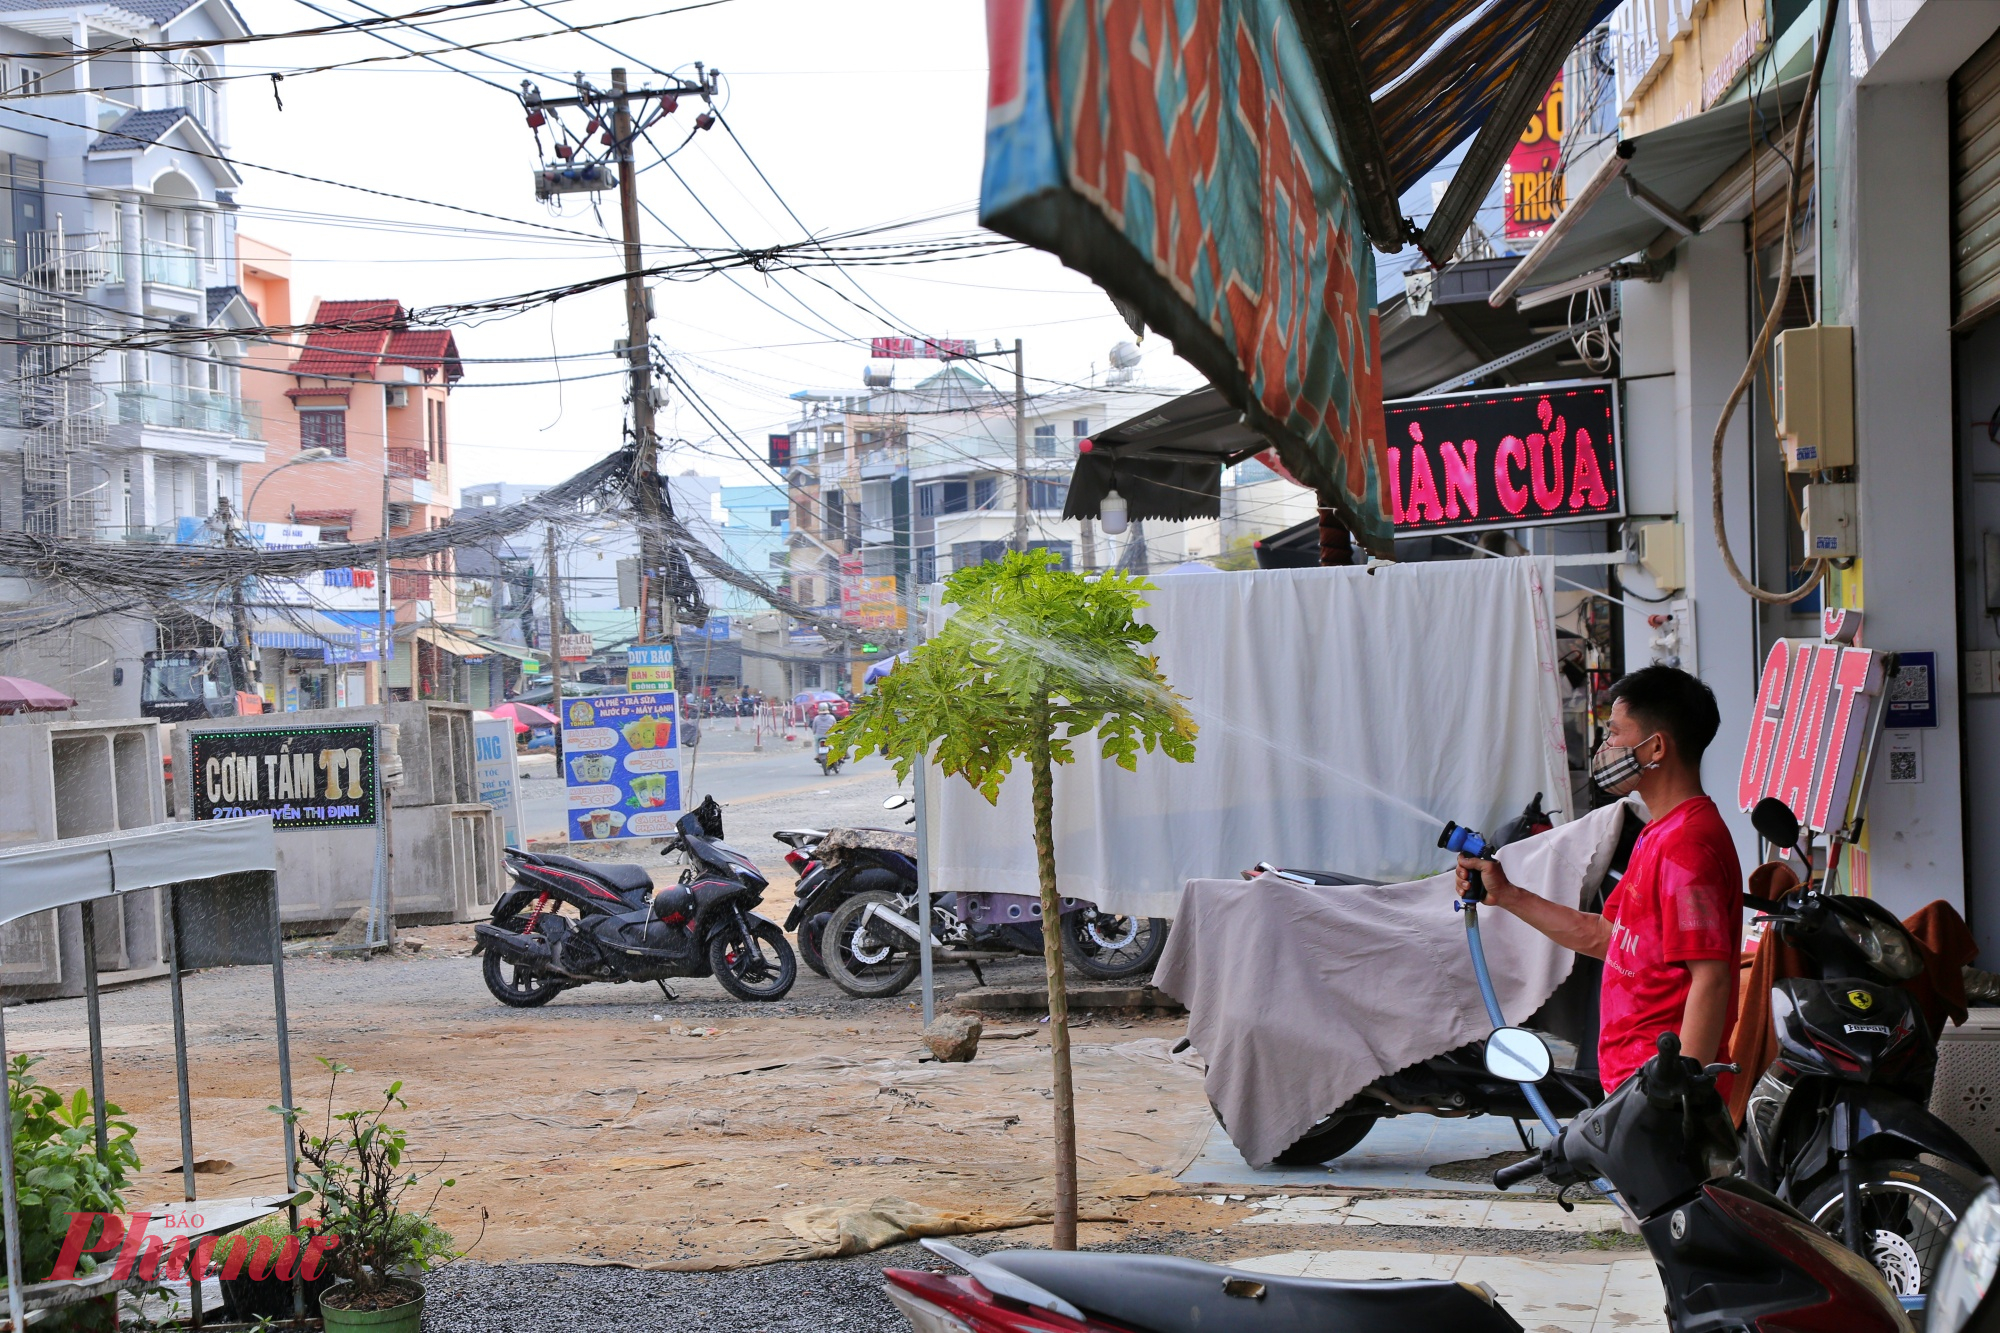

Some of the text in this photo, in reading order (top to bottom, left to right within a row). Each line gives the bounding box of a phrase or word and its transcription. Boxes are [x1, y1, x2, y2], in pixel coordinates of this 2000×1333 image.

[1494, 399, 1609, 514] CỬA
[628, 650, 648, 664] DUY
[594, 696, 656, 708] CÀ PHÊ TRÀ SỮA
[600, 704, 674, 717] NƯỚC ÉP MÁY LẠNH
[578, 737, 612, 749] 29K
[206, 737, 364, 803] CƠM TẤM TI
[640, 759, 675, 770] 24K
[581, 794, 616, 806] 30K
[212, 806, 243, 819] 270
[303, 805, 325, 820] THỊ
[327, 804, 360, 820] ĐỊNH
[635, 814, 667, 824] CÀ PHÊ
[1683, 919, 1716, 928] SAIGON
[1847, 1024, 1888, 1034] Ferrari
